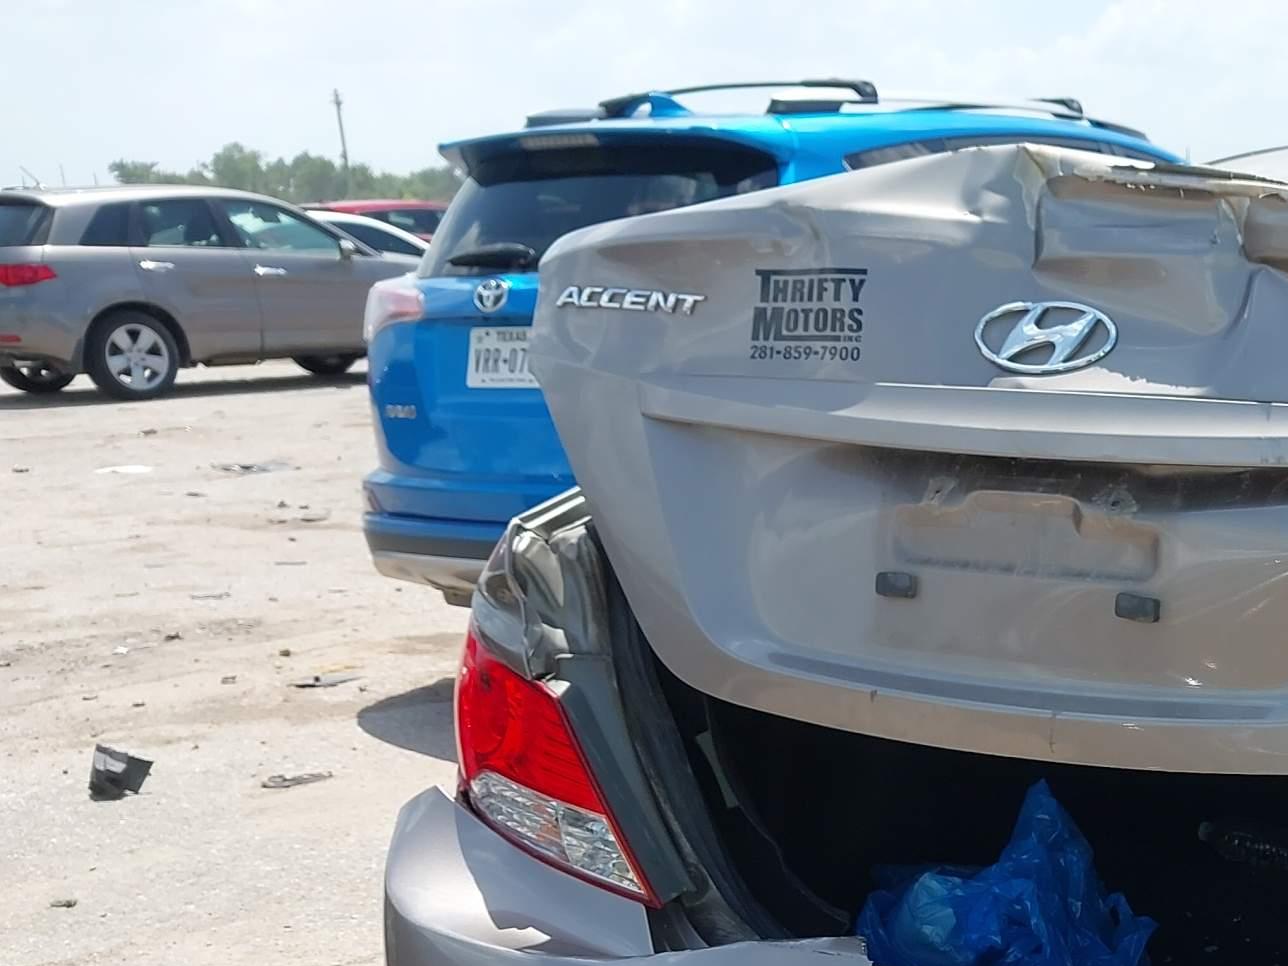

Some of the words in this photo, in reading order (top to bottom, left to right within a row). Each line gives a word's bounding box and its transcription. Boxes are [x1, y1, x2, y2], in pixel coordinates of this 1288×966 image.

[555, 285, 707, 316] ACCENT
[754, 267, 868, 303] THRIFTY
[751, 306, 864, 342] MOTORS
[749, 345, 861, 361] 281-859-7900
